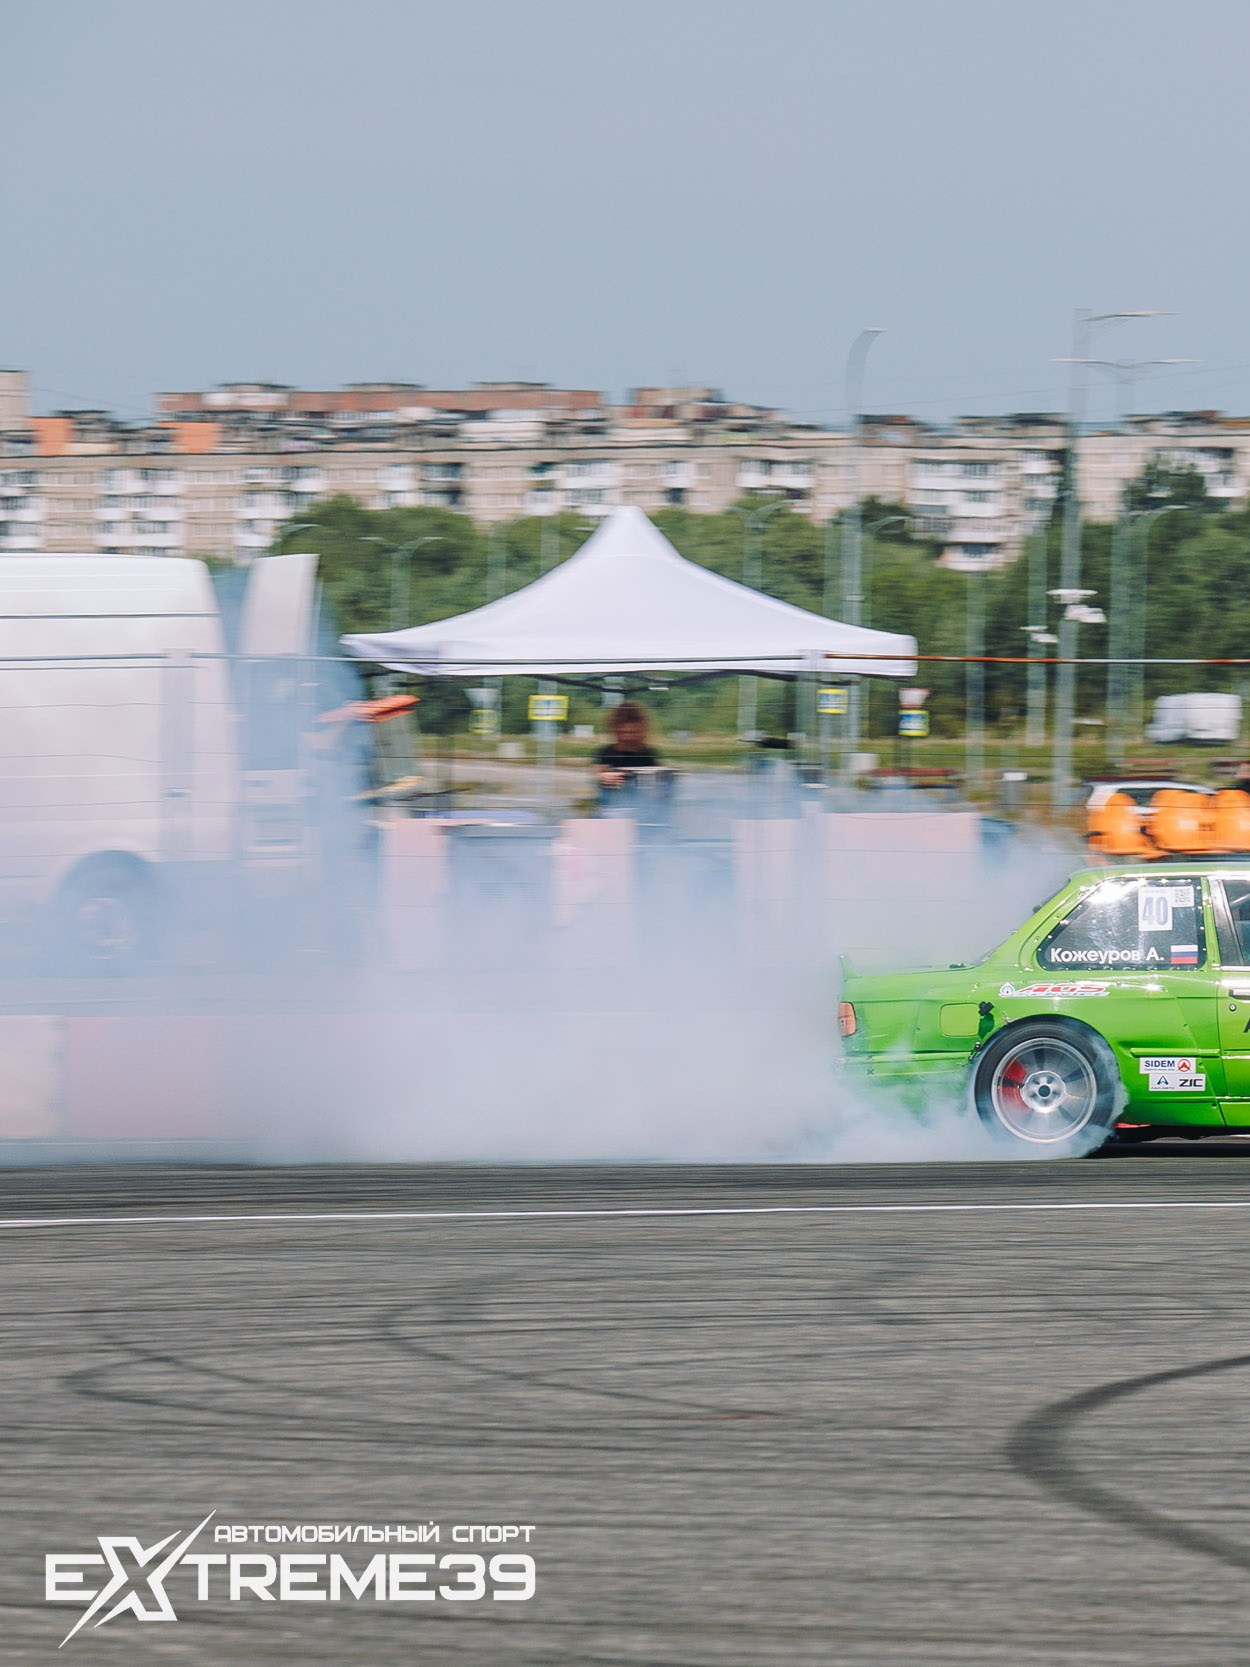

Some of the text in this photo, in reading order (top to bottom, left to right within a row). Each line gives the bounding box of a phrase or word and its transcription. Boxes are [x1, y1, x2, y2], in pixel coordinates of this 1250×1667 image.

[1142, 896, 1168, 925] 40
[1051, 947, 1165, 964] Кожеуров А.
[1144, 1060, 1175, 1068] SIDEM
[1179, 1078, 1204, 1087] ZIC
